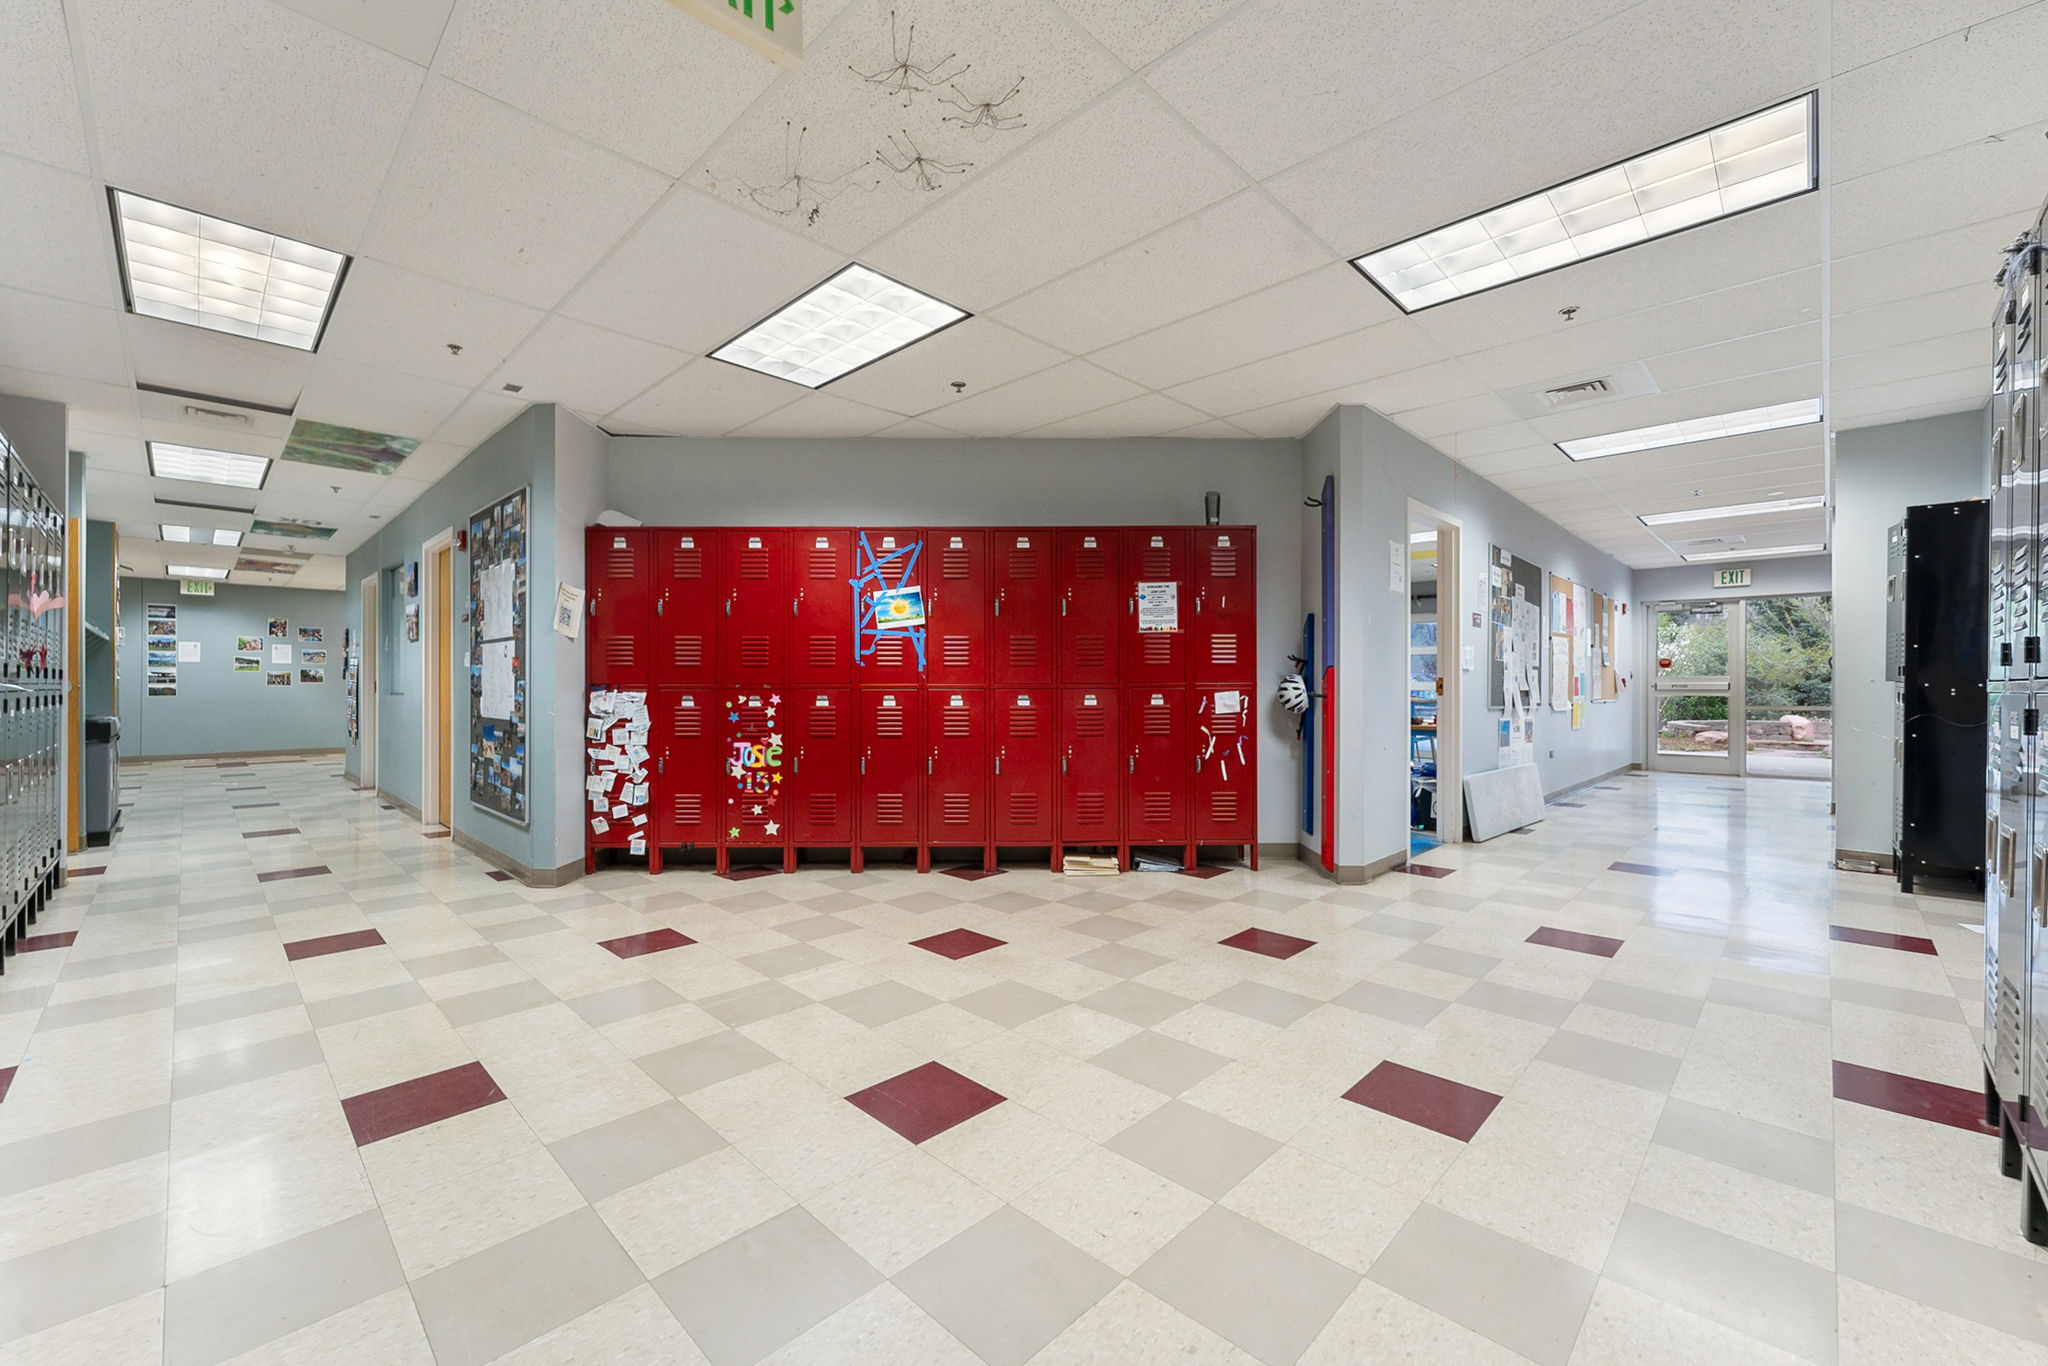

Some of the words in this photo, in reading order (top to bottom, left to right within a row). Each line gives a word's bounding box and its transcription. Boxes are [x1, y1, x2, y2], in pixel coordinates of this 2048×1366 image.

[1721, 570, 1745, 585] EXIT
[187, 580, 209, 593] EXIT
[744, 772, 770, 793] 15
